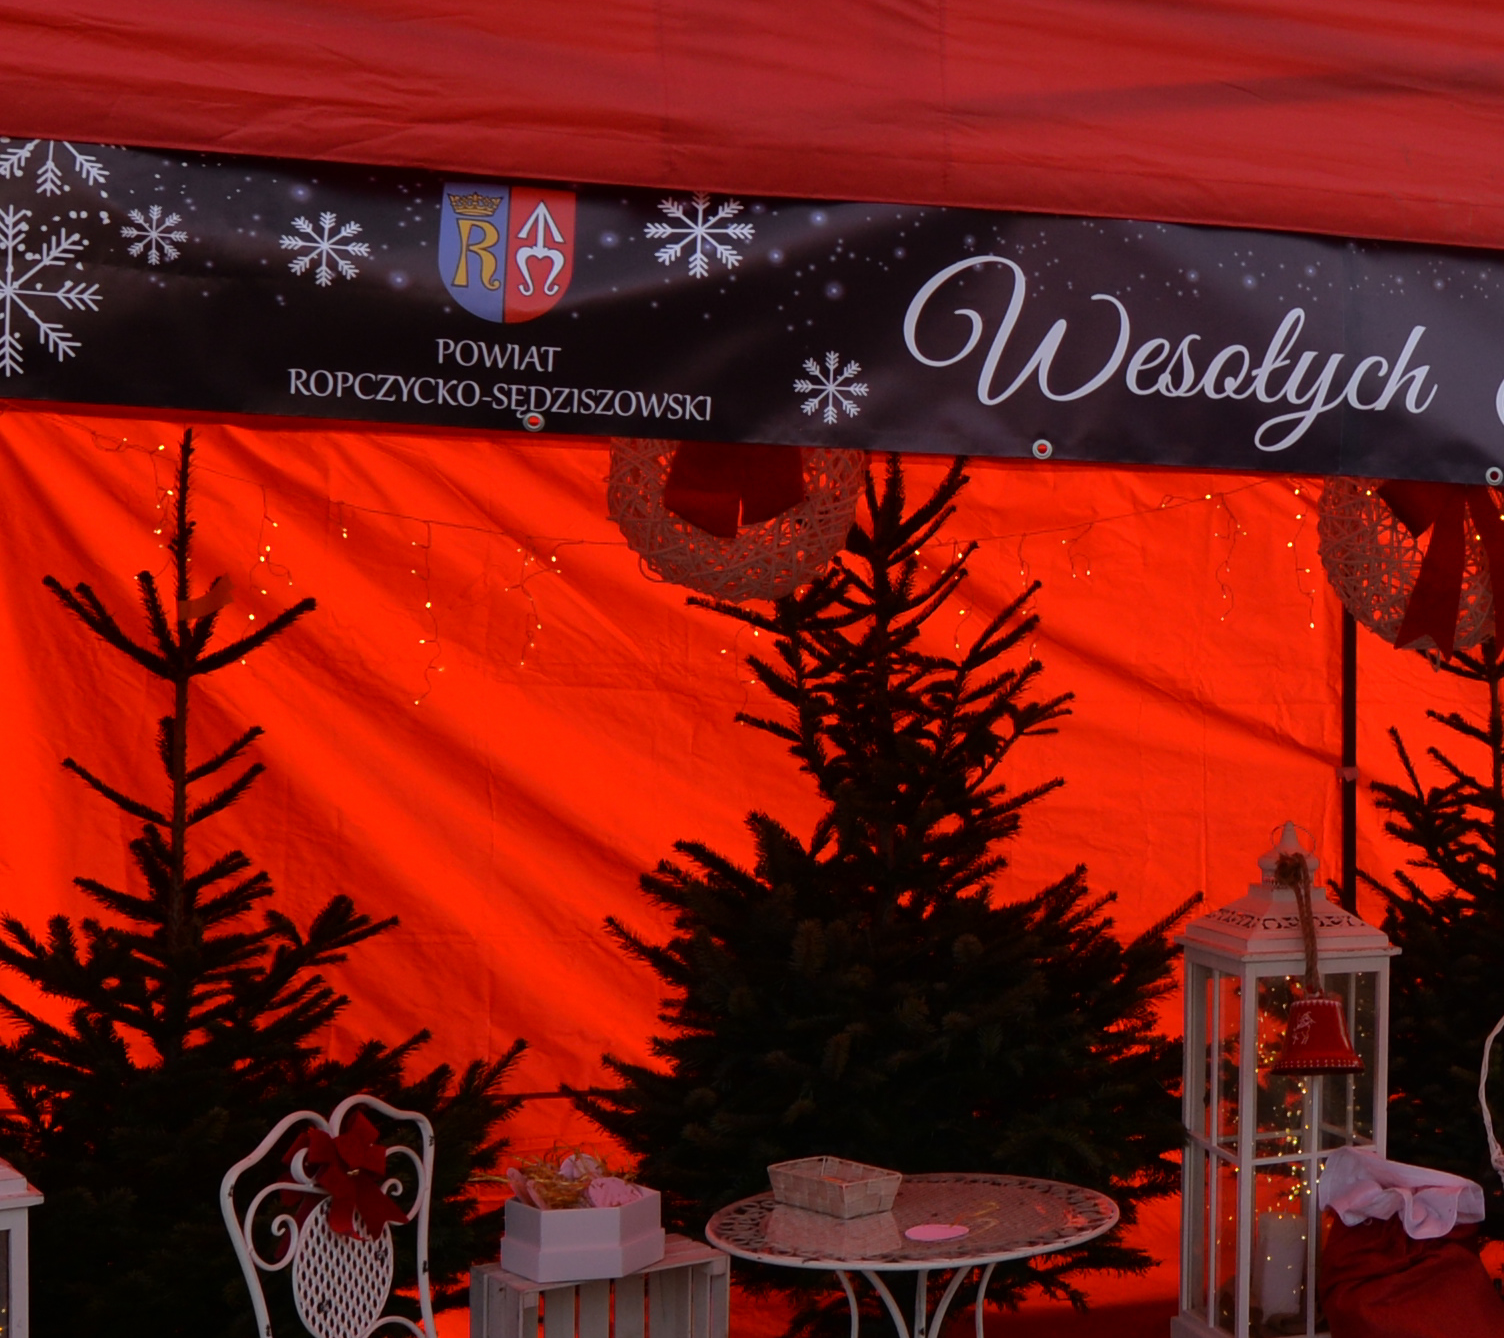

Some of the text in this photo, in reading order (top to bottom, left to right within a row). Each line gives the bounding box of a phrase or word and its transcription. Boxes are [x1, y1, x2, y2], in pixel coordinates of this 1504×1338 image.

[435, 338, 562, 373] POWIAT
[901, 254, 1440, 453] Wesołych
[287, 367, 712, 421] ROPCZYCKO-SĘDZISZOWSKI
